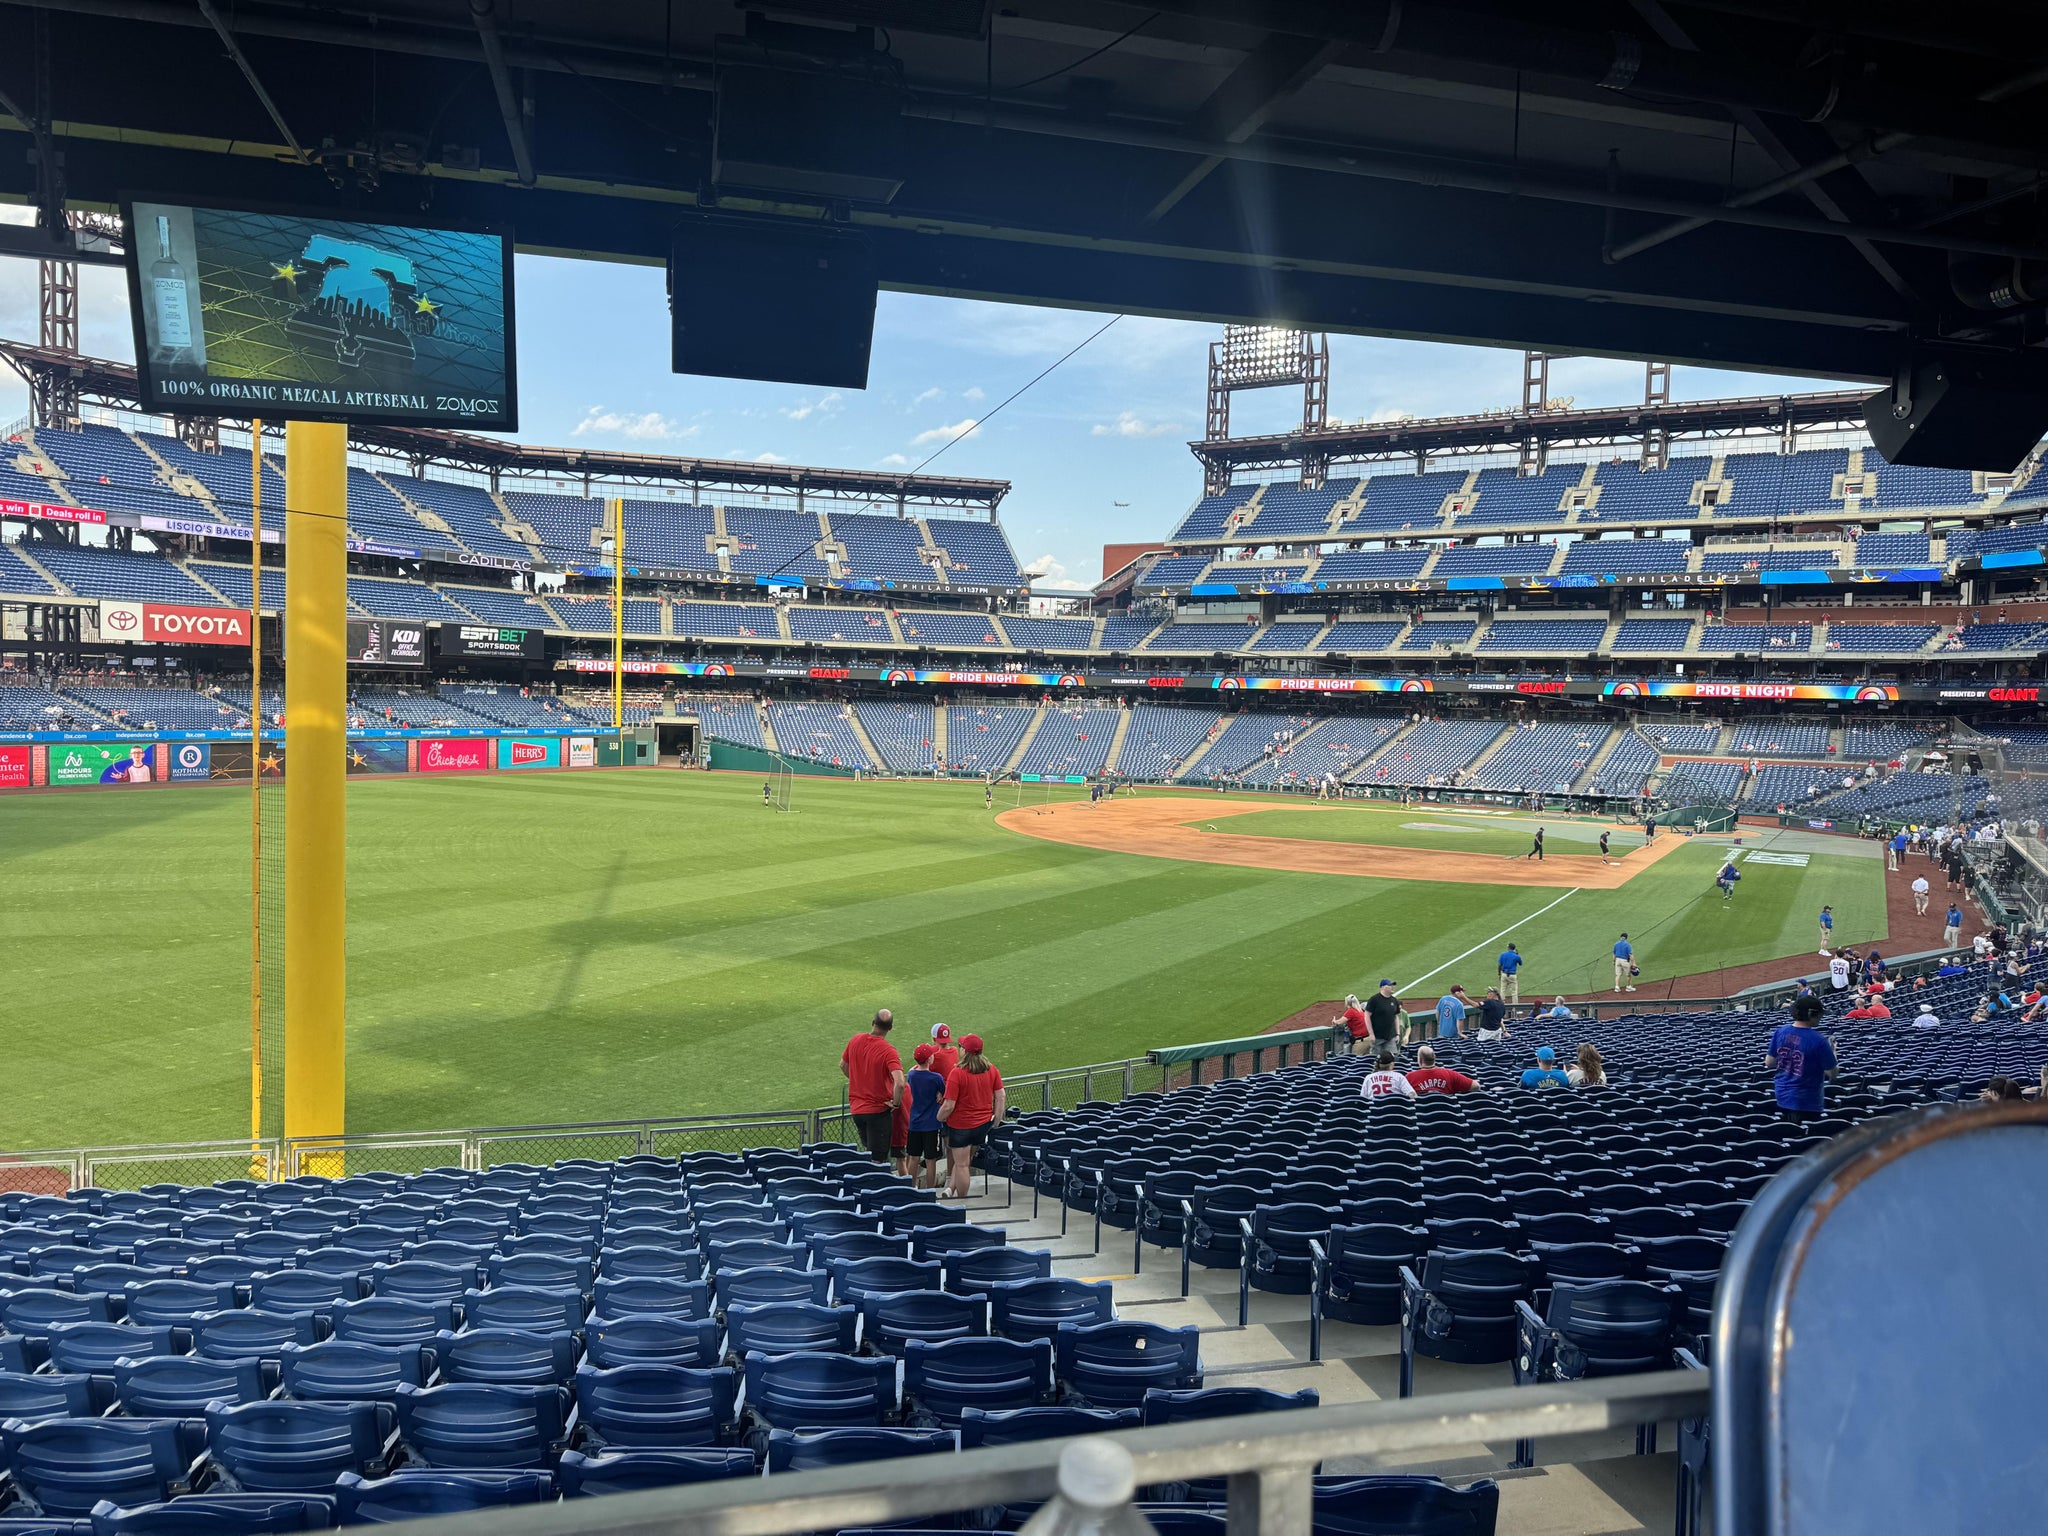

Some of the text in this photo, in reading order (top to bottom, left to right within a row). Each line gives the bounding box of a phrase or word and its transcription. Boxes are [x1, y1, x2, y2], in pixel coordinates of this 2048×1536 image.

[160, 380, 205, 396] 100%
[210, 383, 277, 400] ORGANIC
[282, 387, 341, 405] MEZCAL
[344, 391, 429, 409] ARTESENAL
[6, 504, 24, 513] win
[46, 508, 73, 518] Deals
[75, 512, 91, 520] roll
[93, 512, 102, 522] in
[166, 520, 213, 535] LISCIO'S
[458, 553, 532, 571] CADILLAC
[149, 613, 243, 636] TOYOTA
[391, 629, 421, 643] KDI
[460, 626, 528, 642] ESPN BET
[468, 641, 521, 651] SPORTSBOOK
[576, 660, 658, 673] PRIDE NIGHT
[809, 668, 850, 679] GIANT
[950, 673, 1019, 683] PRIDE NIGHT
[1147, 677, 1184, 687] GIANT
[1281, 680, 1356, 689] PRIDE NIGHT
[1517, 682, 1567, 693] GIANT
[1695, 685, 1796, 697] PRIDE NIGHT
[1988, 688, 2039, 701] GIANT
[515, 747, 543, 759] HERR'S
[572, 744, 591, 752] WM
[1833, 966, 1845, 976] 20
[1371, 1083, 1393, 1095] 25
[1418, 1078, 1447, 1091] HARPER
